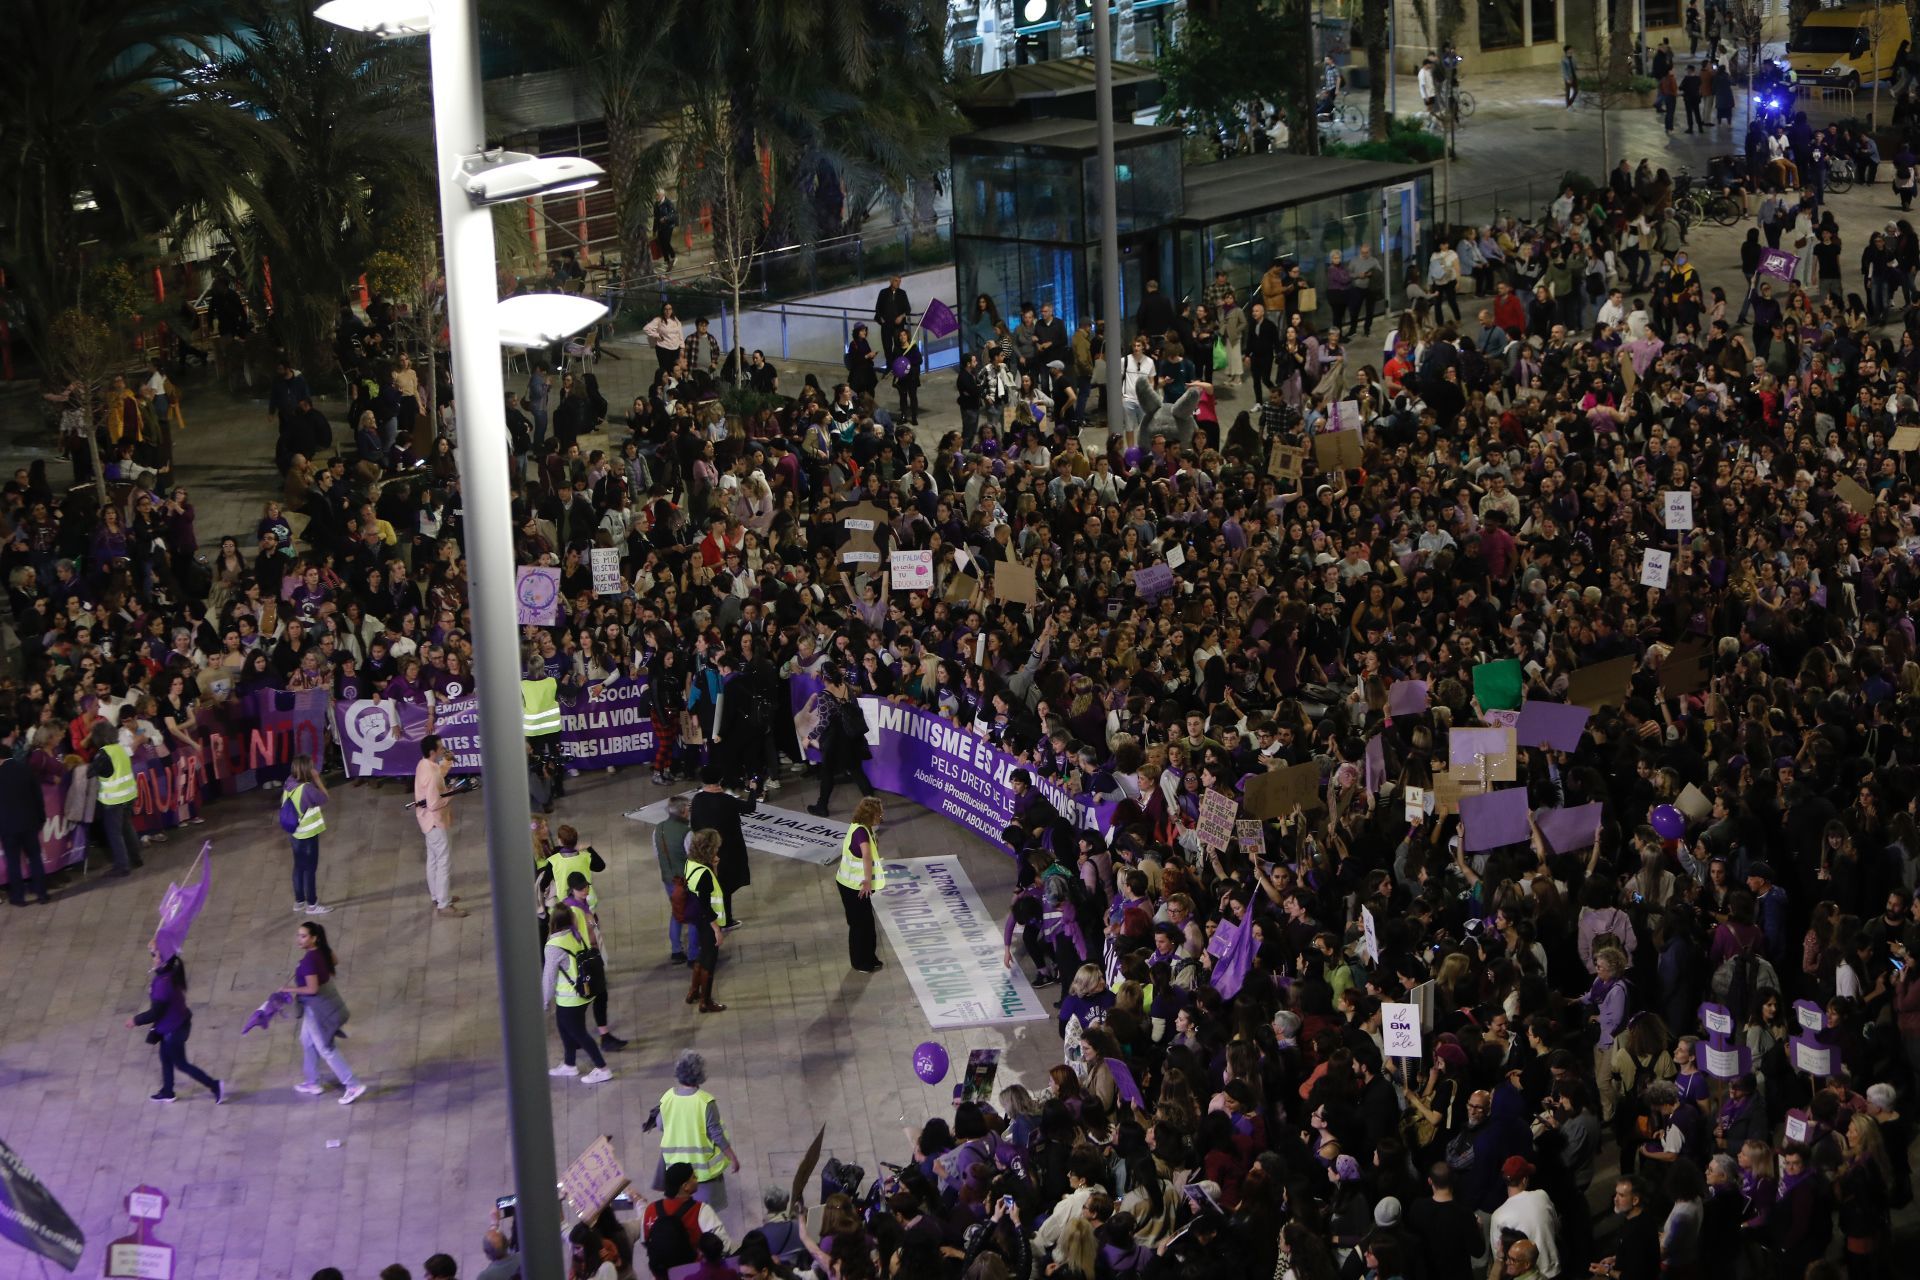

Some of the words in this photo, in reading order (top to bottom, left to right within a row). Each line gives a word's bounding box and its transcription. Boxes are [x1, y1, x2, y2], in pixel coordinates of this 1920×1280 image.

[441, 737, 470, 750] TES
[473, 736, 482, 749] S
[561, 714, 588, 731] TRA
[590, 712, 609, 728] LA
[610, 707, 651, 727] VIOL
[879, 704, 972, 762] MINISME
[975, 741, 993, 774] ÉS
[561, 739, 598, 758] ERES
[600, 732, 654, 755] LIBRES!
[914, 768, 943, 790] Abolició
[931, 755, 959, 779] PELS
[961, 769, 992, 797] DRETS
[1003, 796, 1016, 814] LE
[1206, 790, 1233, 809] SOMOS
[740, 811, 775, 821] EM
[773, 816, 849, 842] VALÈNC
[942, 799, 967, 820] FRONT
[966, 813, 1005, 844] ABOLICIONI
[1196, 829, 1224, 848] QUEMAR
[926, 863, 948, 874] LA
[931, 874, 985, 929] PROSTITUCIÓ
[887, 896, 953, 957] VIOLÈNCIA
[962, 930, 988, 943] NO
[915, 956, 977, 1005] SEXUAL
[1390, 1022, 1411, 1030] 8M
[1393, 1008, 1407, 1022] el
[1392, 1034, 1416, 1049] sale
